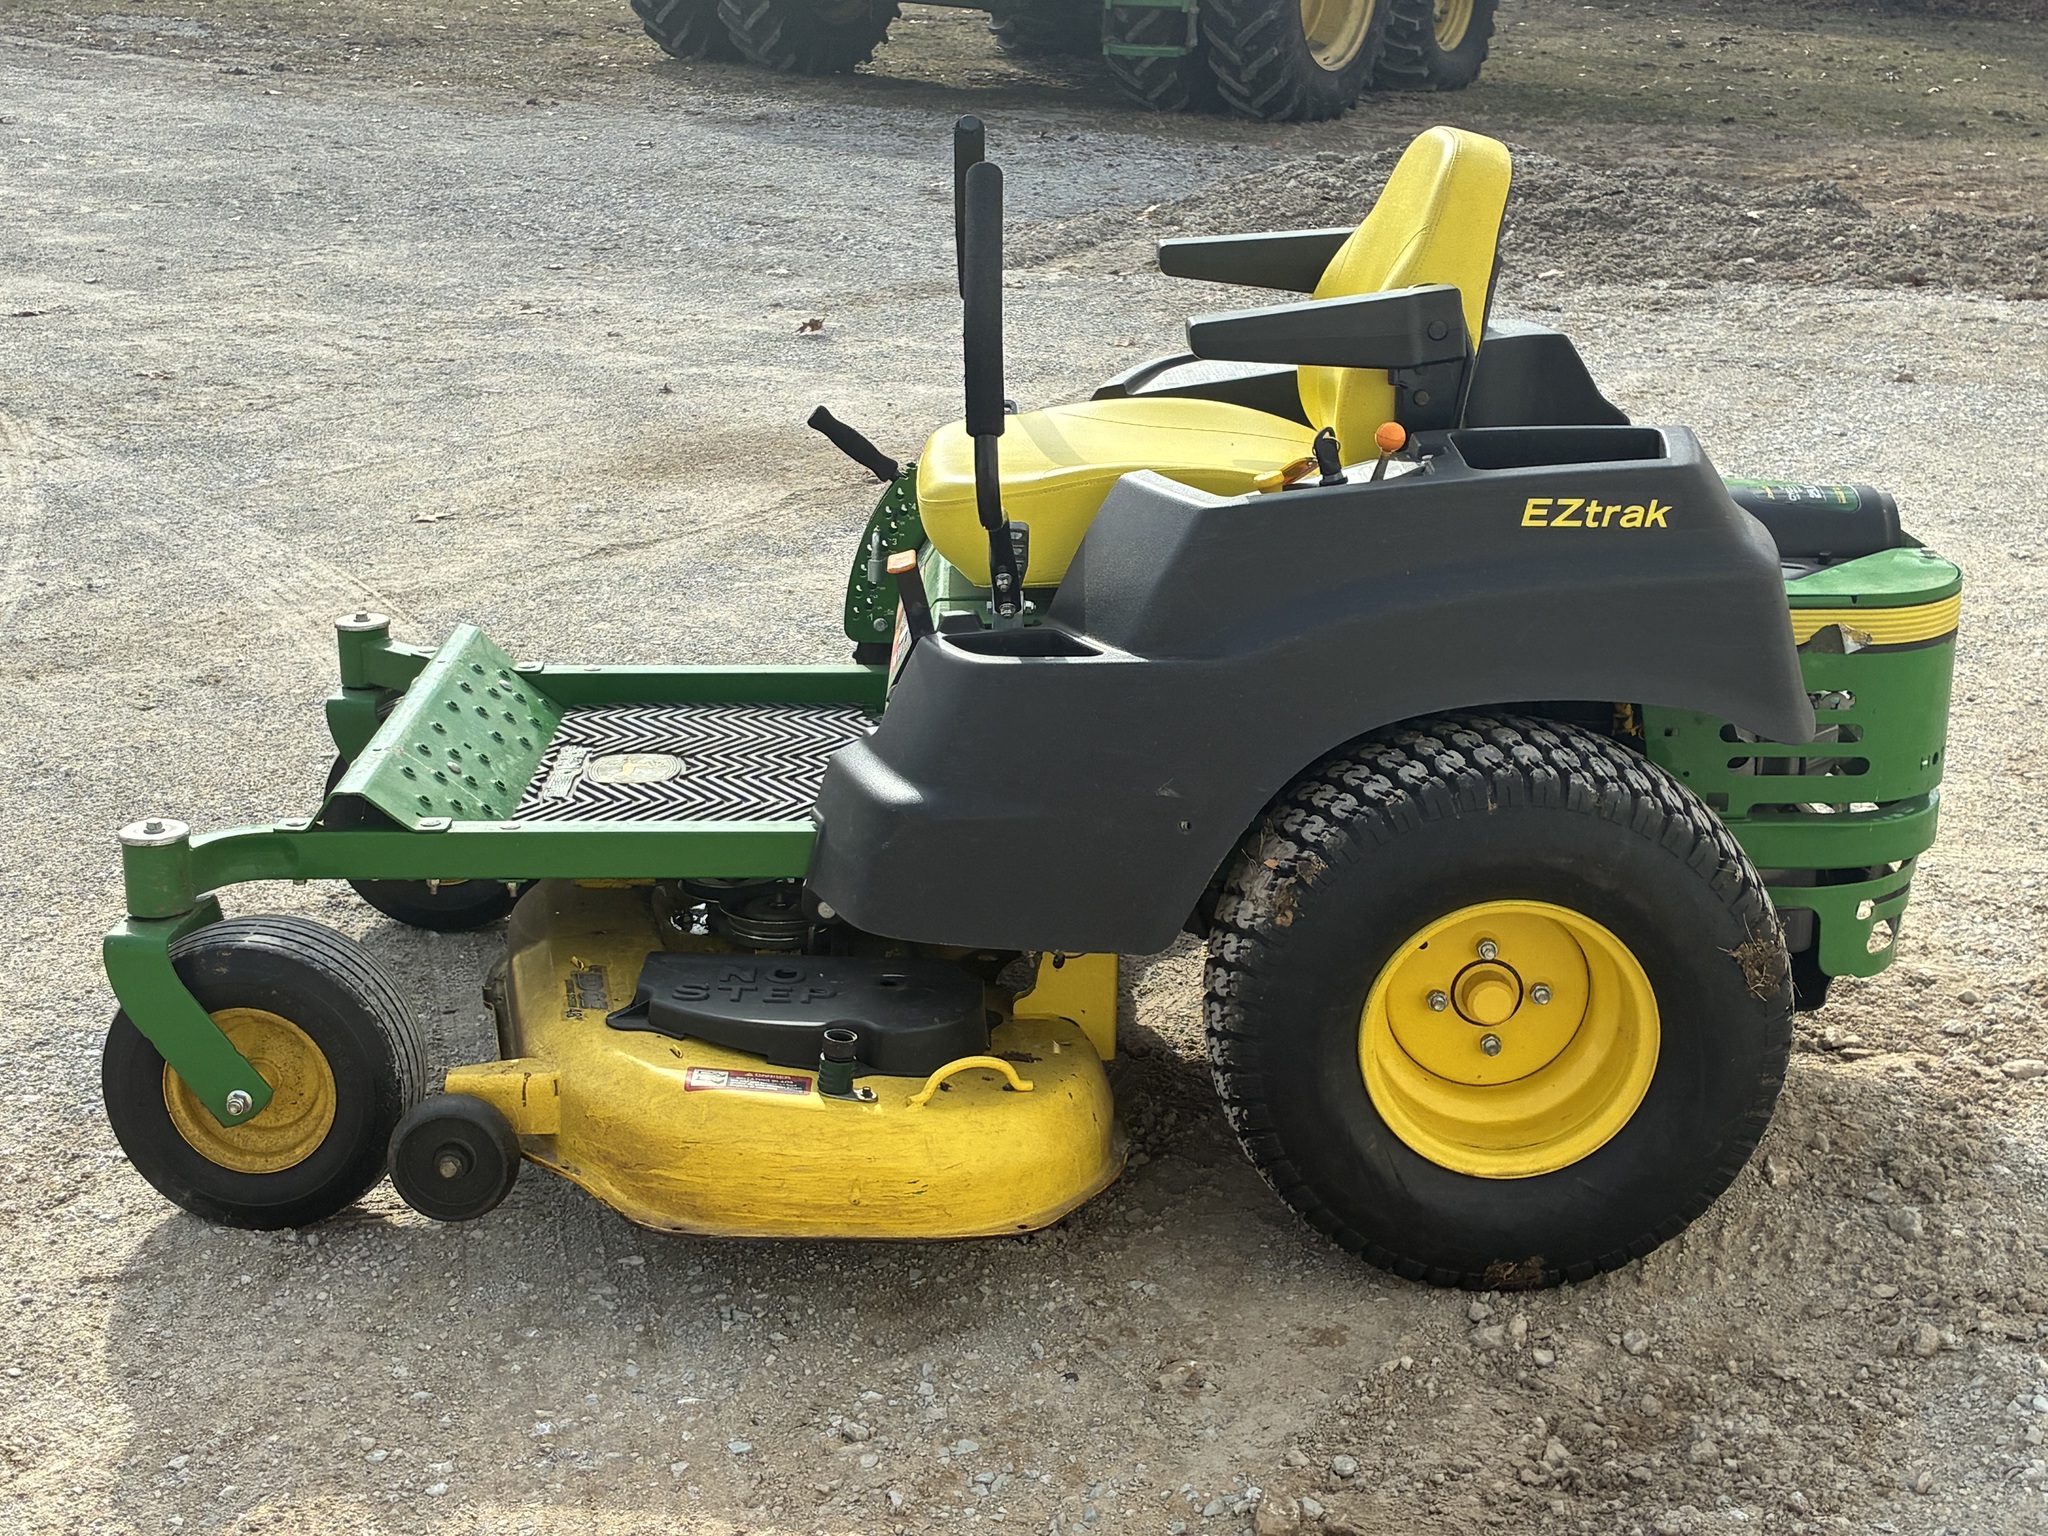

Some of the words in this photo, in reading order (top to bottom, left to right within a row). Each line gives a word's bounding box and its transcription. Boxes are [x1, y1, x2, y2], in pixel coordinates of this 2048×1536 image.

[1520, 497, 1674, 529] EZtrak
[719, 965, 807, 984] NO
[671, 983, 838, 1005] STEP
